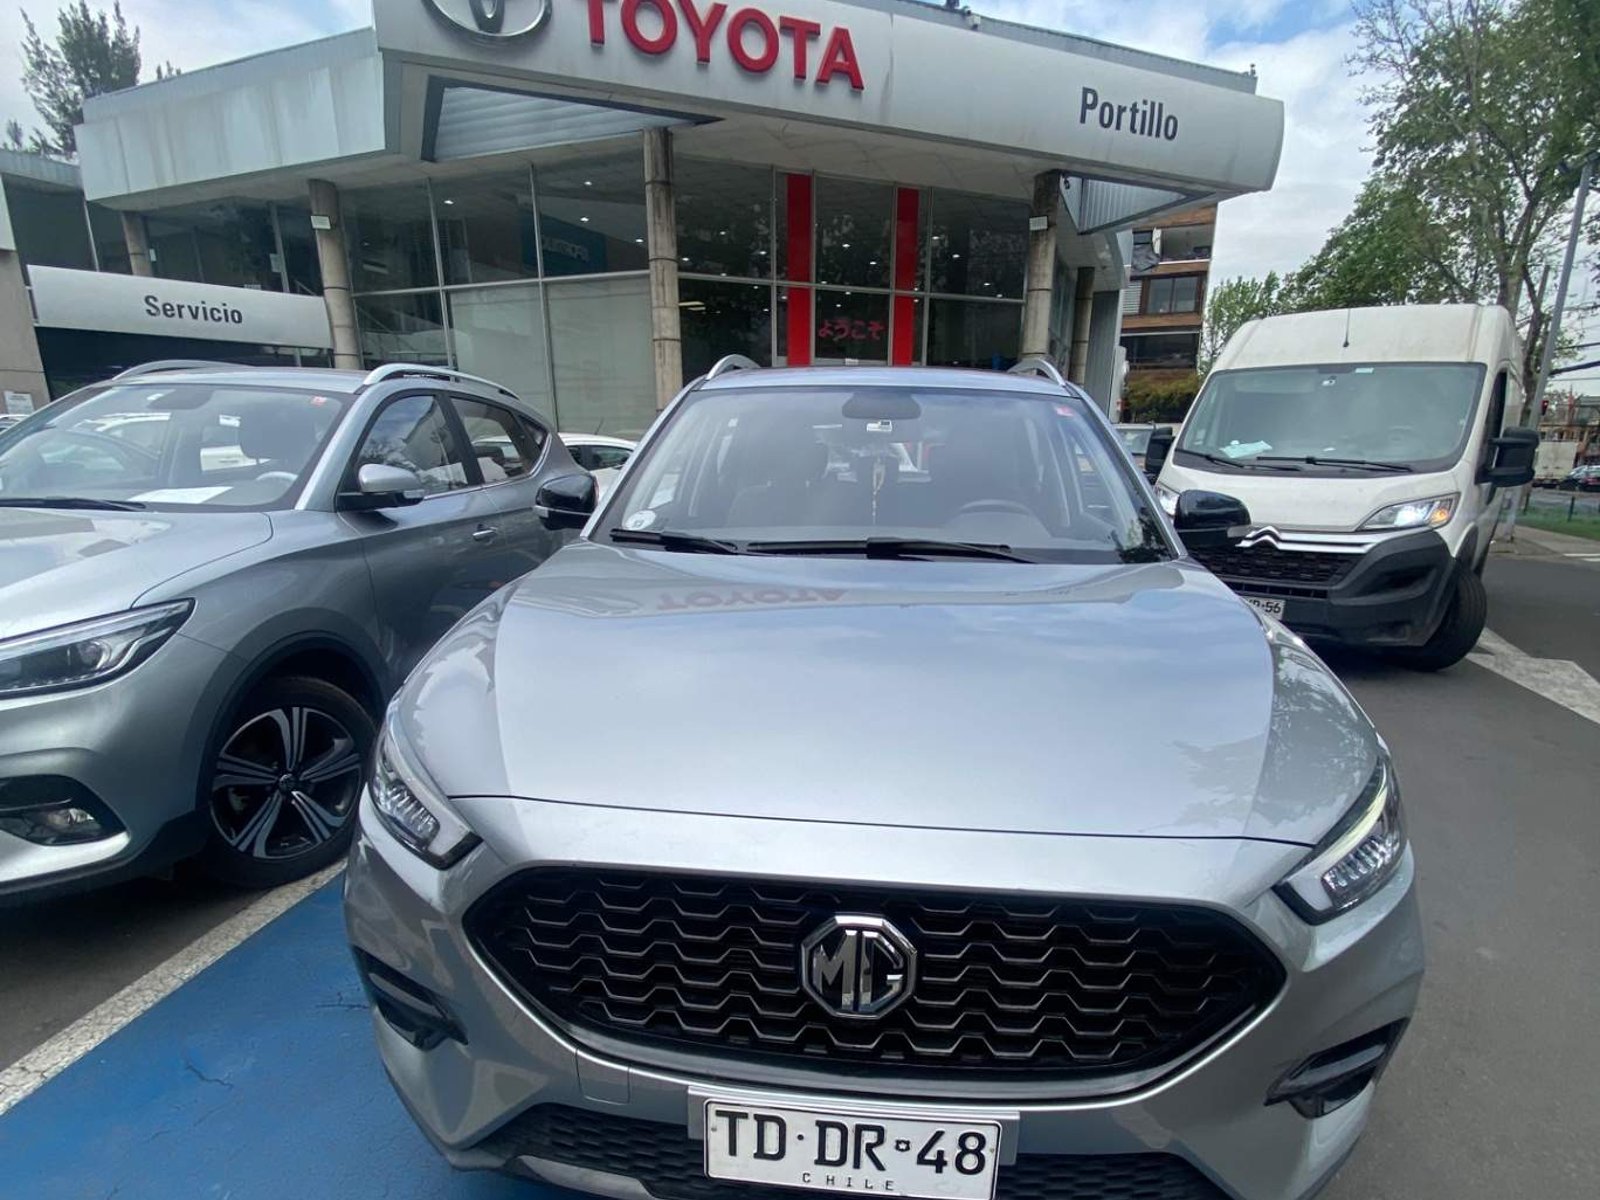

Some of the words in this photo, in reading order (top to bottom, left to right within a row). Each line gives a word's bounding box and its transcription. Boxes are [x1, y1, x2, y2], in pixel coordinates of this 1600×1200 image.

[586, 0, 864, 90] TOYOTA
[1080, 86, 1178, 141] Portillo
[144, 295, 243, 324] Servicio
[811, 929, 904, 1013] MG
[802, 1172, 895, 1191] CHILE
